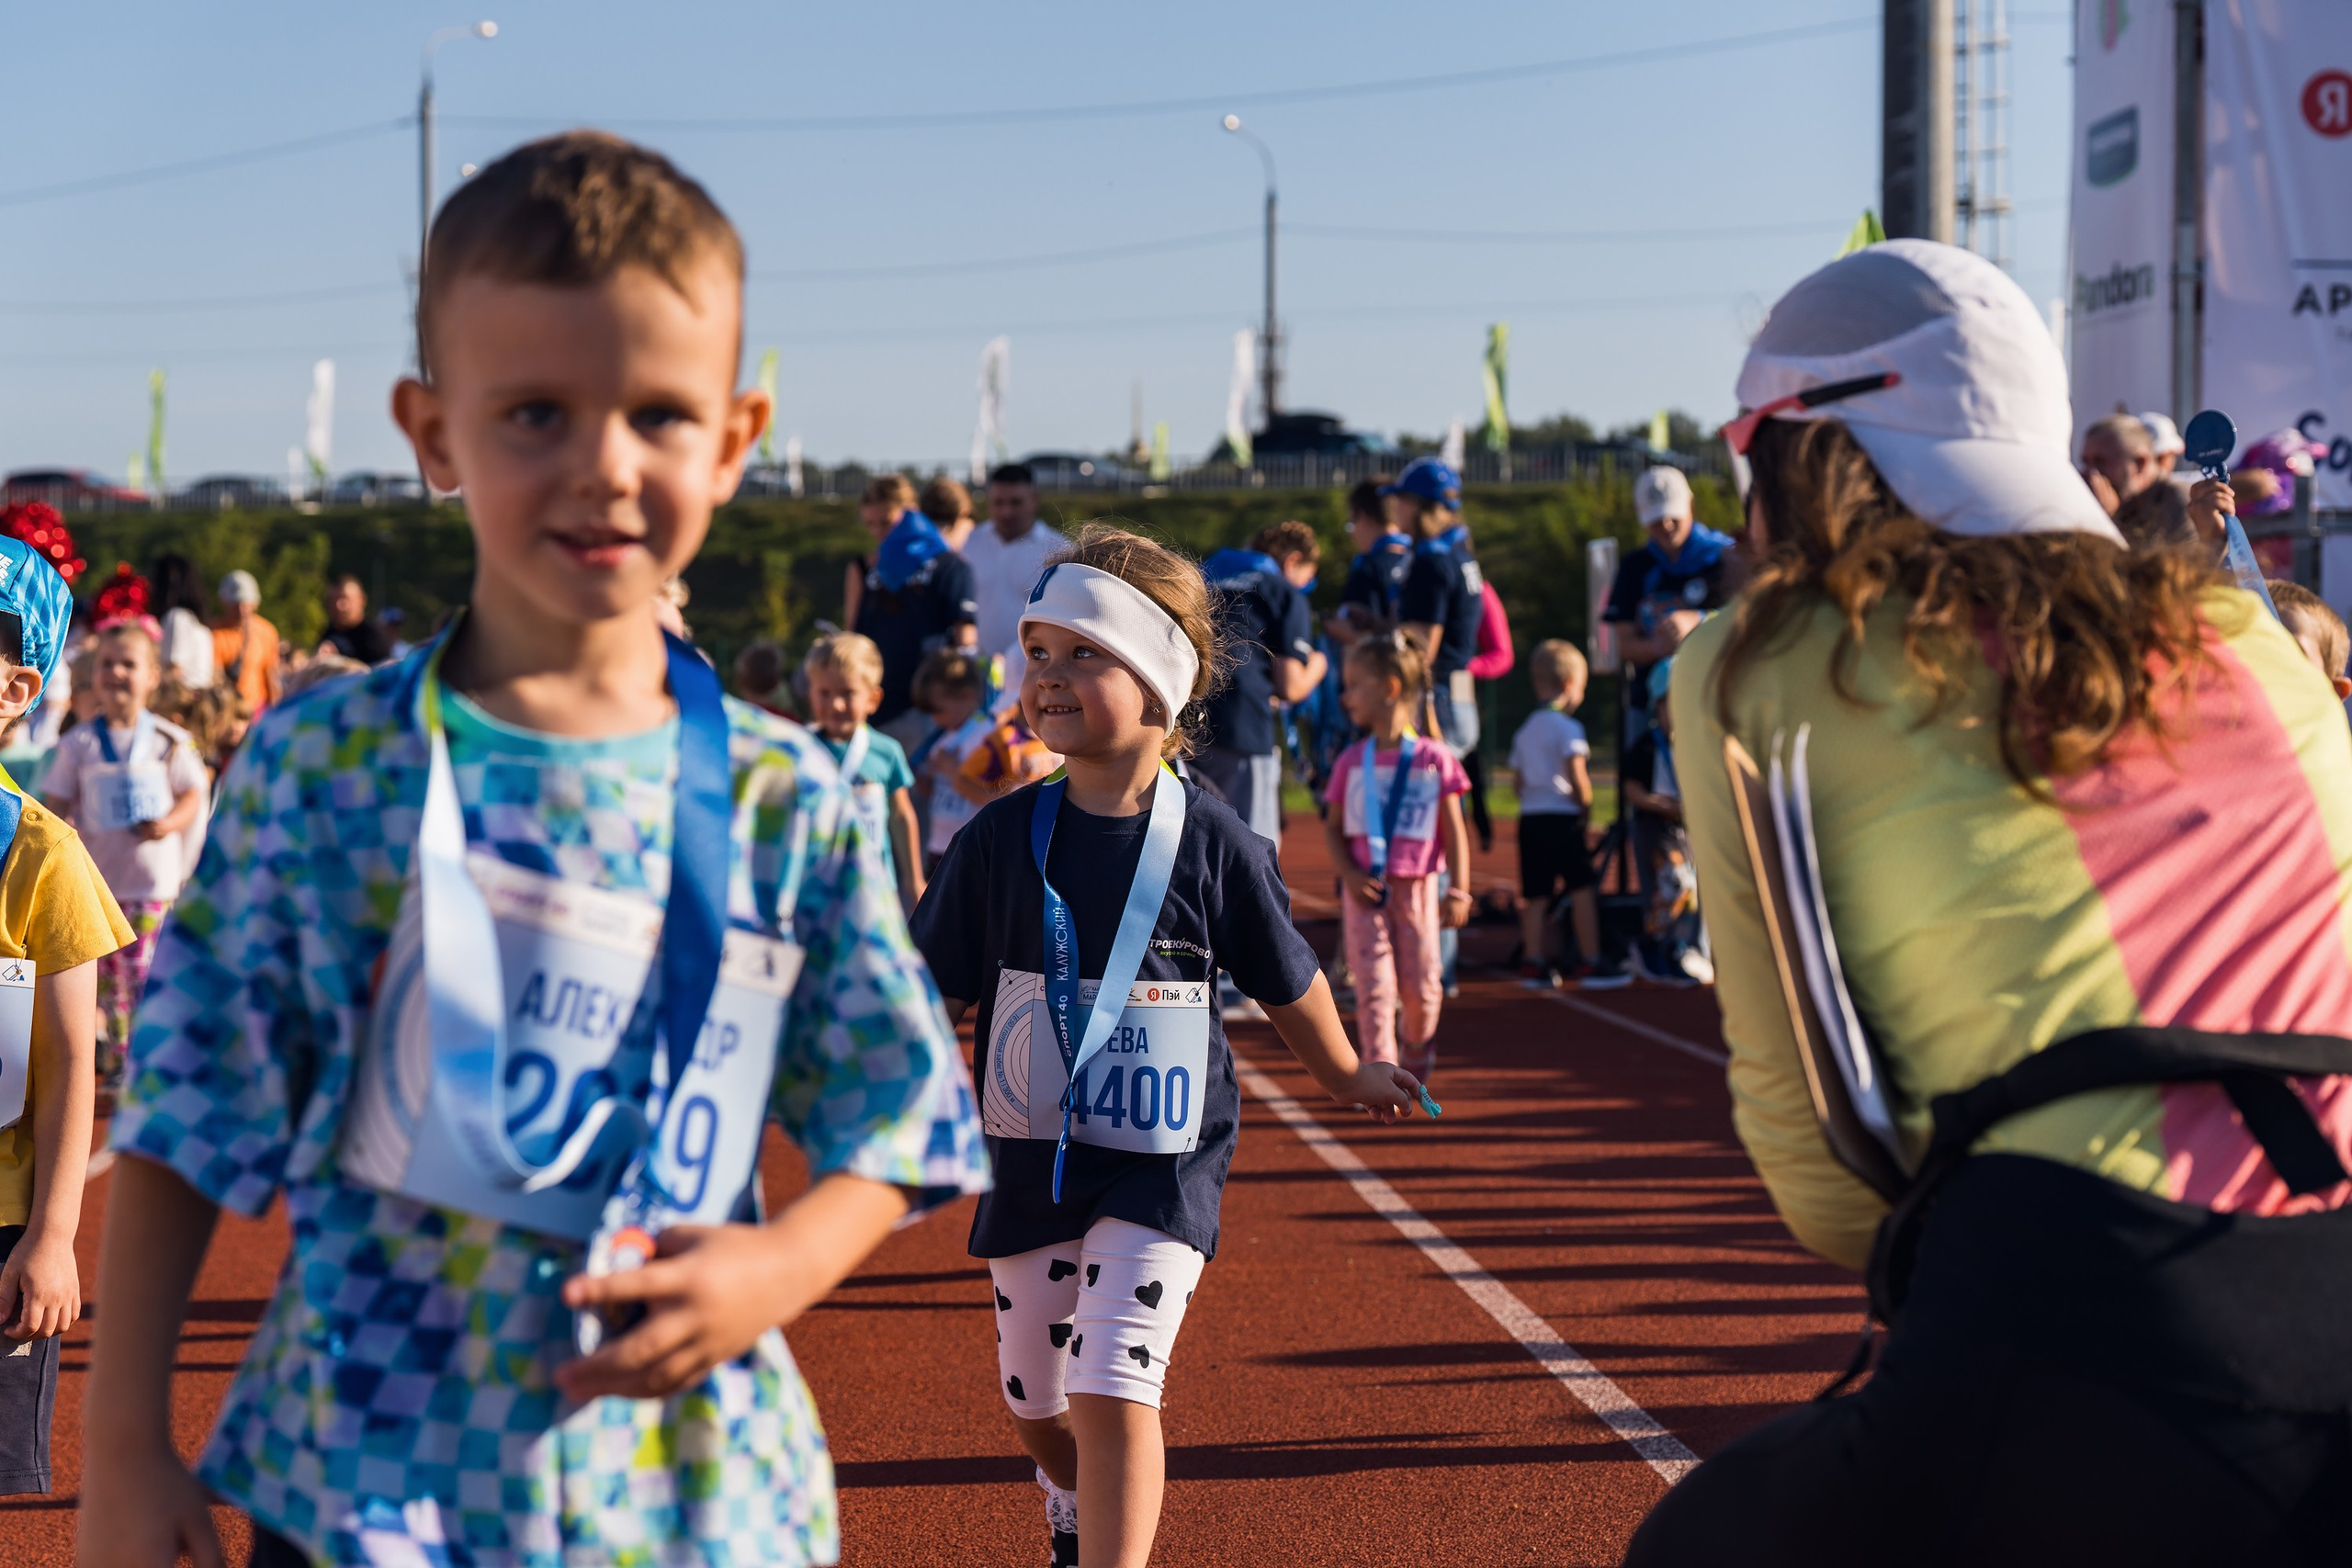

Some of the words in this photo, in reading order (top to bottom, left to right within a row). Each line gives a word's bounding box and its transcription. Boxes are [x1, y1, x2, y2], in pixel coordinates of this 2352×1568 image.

[1053, 908, 1069, 981] КАЛУЖСКИЙ
[1058, 995, 1069, 1010] 40
[1162, 989, 1181, 1000] Пэй
[1058, 1013, 1072, 1058] СПОРТ
[1107, 1026, 1149, 1054] ЕВА
[1058, 1065, 1191, 1132] 4400
